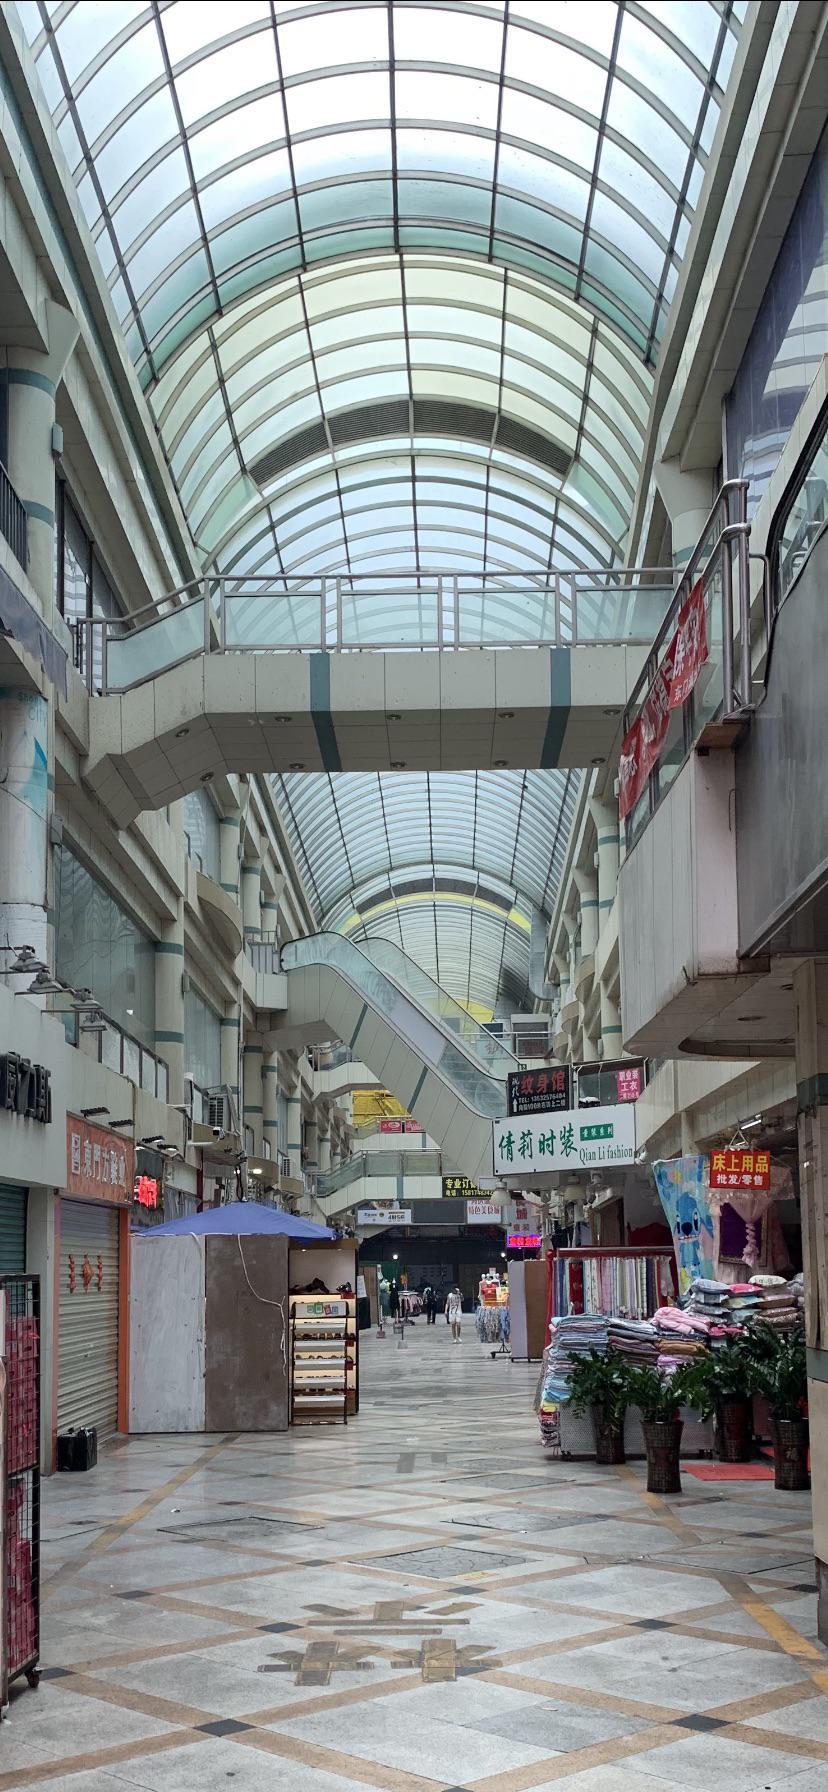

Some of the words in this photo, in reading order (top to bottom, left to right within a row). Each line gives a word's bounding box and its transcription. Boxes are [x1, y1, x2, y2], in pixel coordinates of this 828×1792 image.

[520, 1071, 566, 1095] 纹身馆
[498, 1122, 578, 1162] 倩莉时装
[579, 1148, 596, 1165] Qian
[598, 1146, 605, 1160] Li
[607, 1144, 633, 1159] fashion
[712, 1154, 768, 1173] 床上用品
[716, 1173, 763, 1186] 批发/零售
